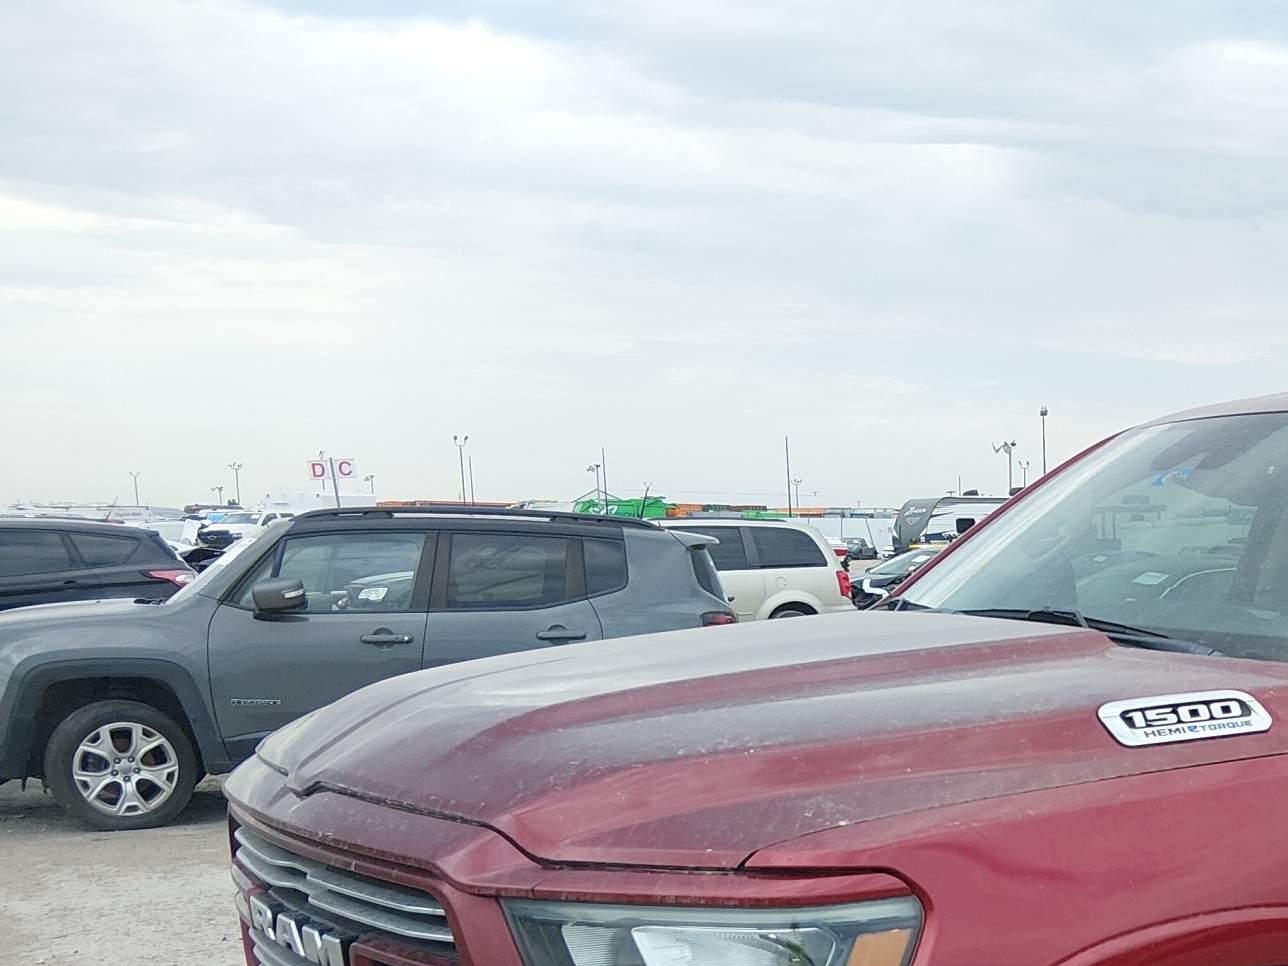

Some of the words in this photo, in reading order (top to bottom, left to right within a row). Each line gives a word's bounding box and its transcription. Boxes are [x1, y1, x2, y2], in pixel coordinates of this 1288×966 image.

[311, 463, 325, 477] D
[338, 461, 353, 476] C
[1125, 700, 1243, 729] 1500
[1144, 727, 1186, 738] HEMI
